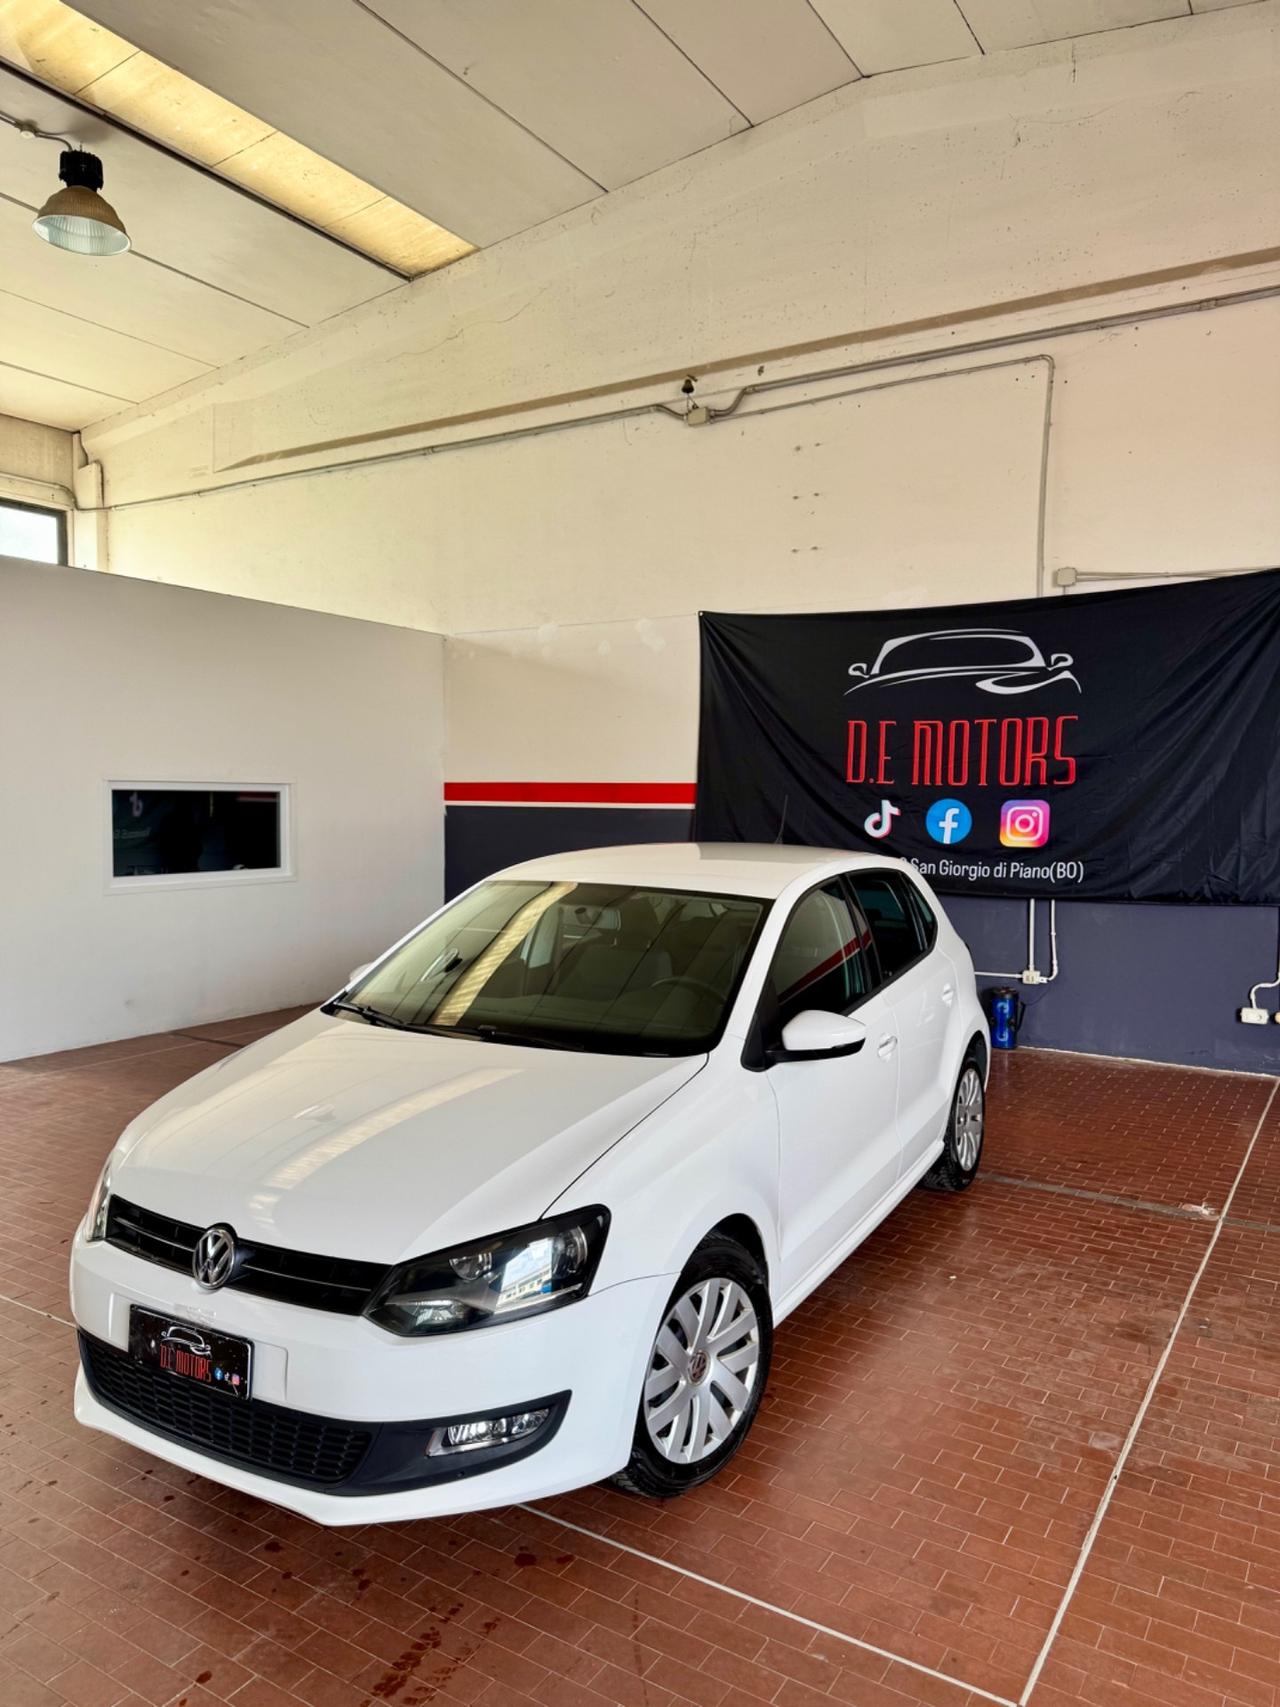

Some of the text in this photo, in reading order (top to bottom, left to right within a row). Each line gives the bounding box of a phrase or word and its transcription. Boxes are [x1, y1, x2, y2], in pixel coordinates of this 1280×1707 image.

[846, 715, 1079, 787] D.E MOTORS
[939, 859, 990, 881] Giorgio
[993, 862, 1007, 878] di
[1010, 861, 1085, 883] Piano(BO)
[175, 1349, 212, 1383] MOTORS
